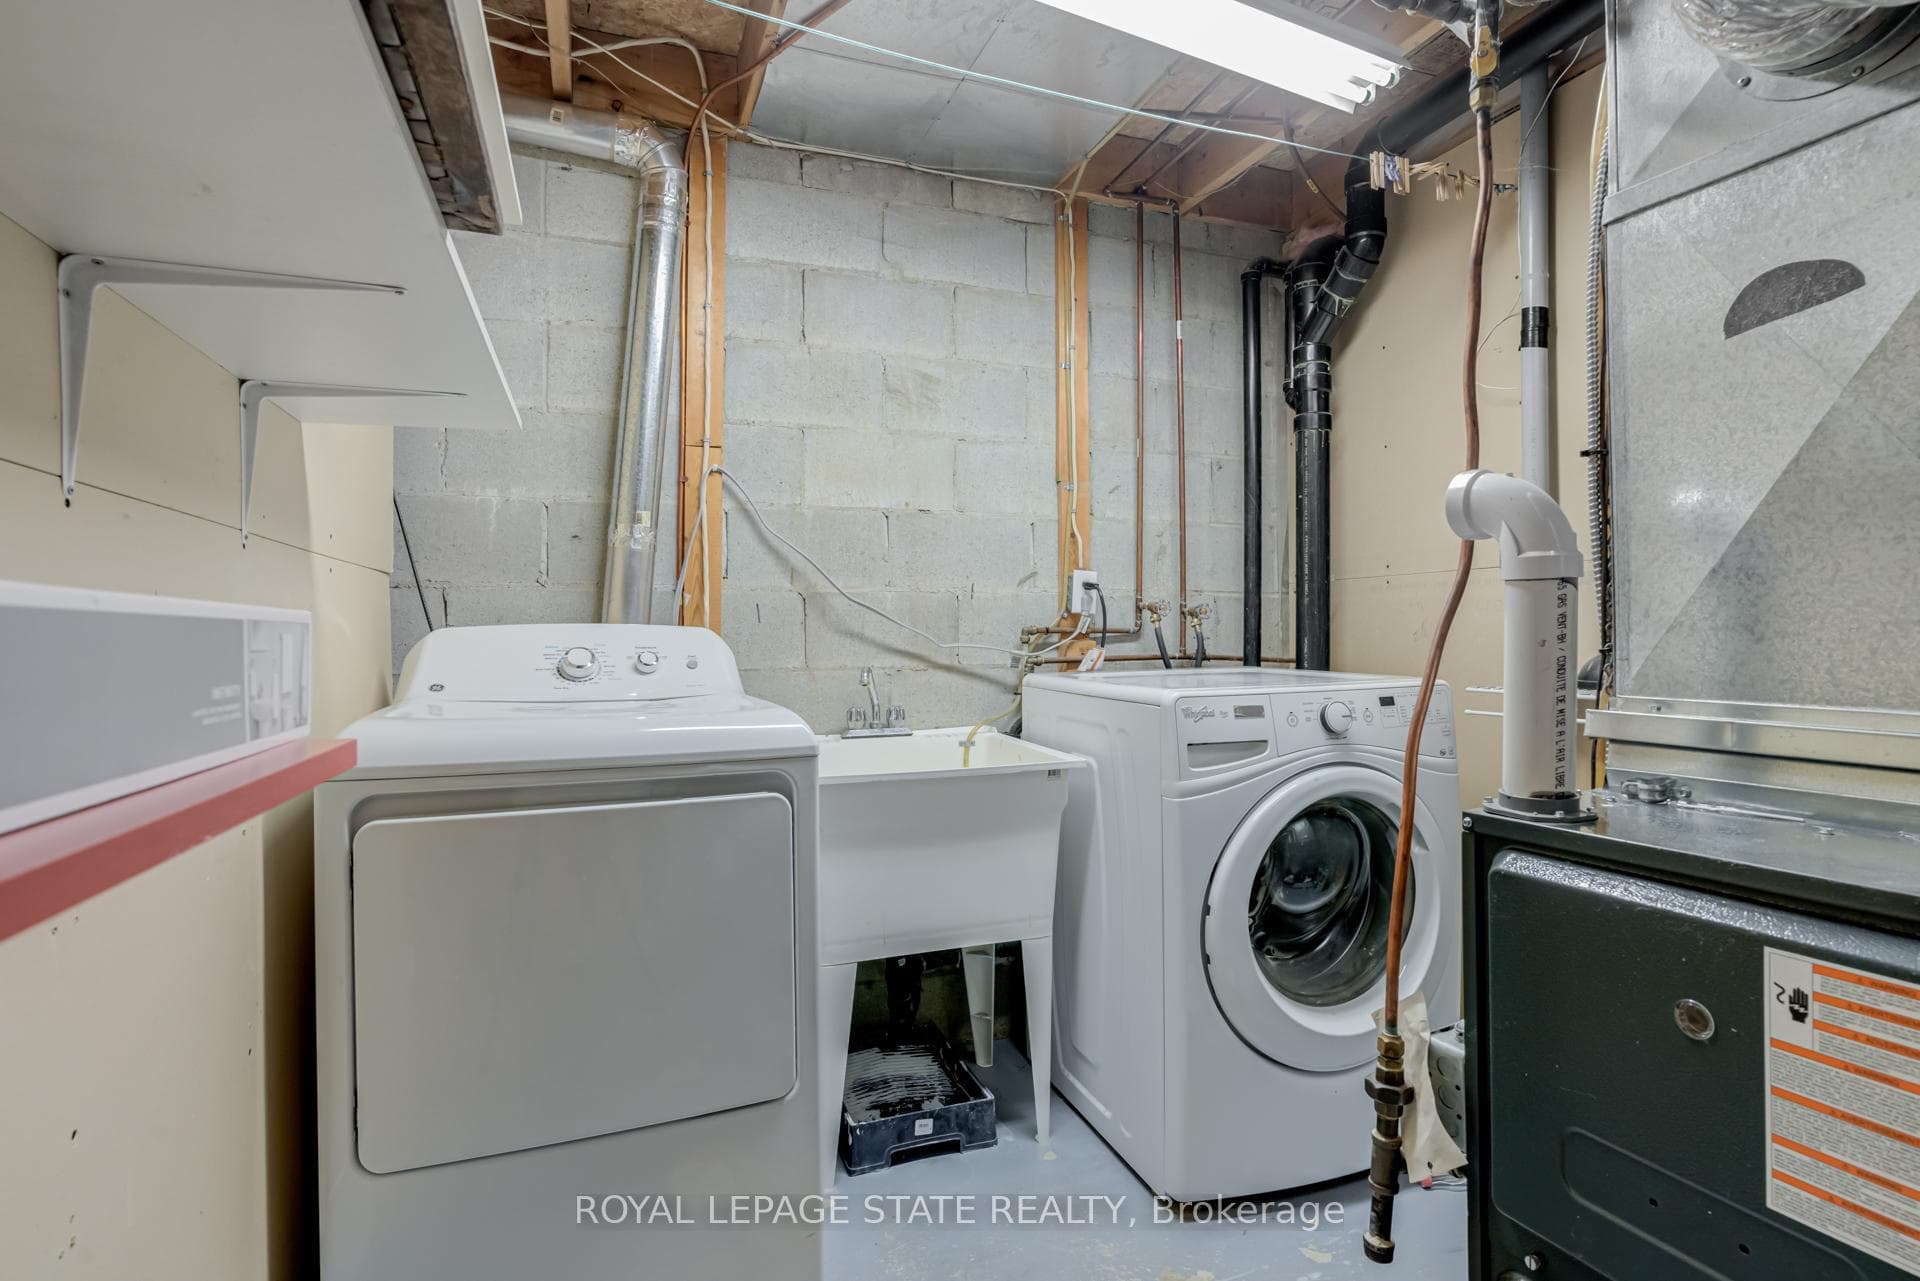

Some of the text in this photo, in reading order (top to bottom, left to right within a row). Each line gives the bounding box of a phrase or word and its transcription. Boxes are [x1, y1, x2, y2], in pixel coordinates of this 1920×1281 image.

[1557, 593, 1567, 608] GAS
[1556, 655, 1567, 692] CONDUITE
[1556, 694, 1566, 705] DE
[1556, 708, 1566, 728] MISE
[1555, 739, 1566, 763] L'AIR
[1555, 765, 1566, 790] LIBRE
